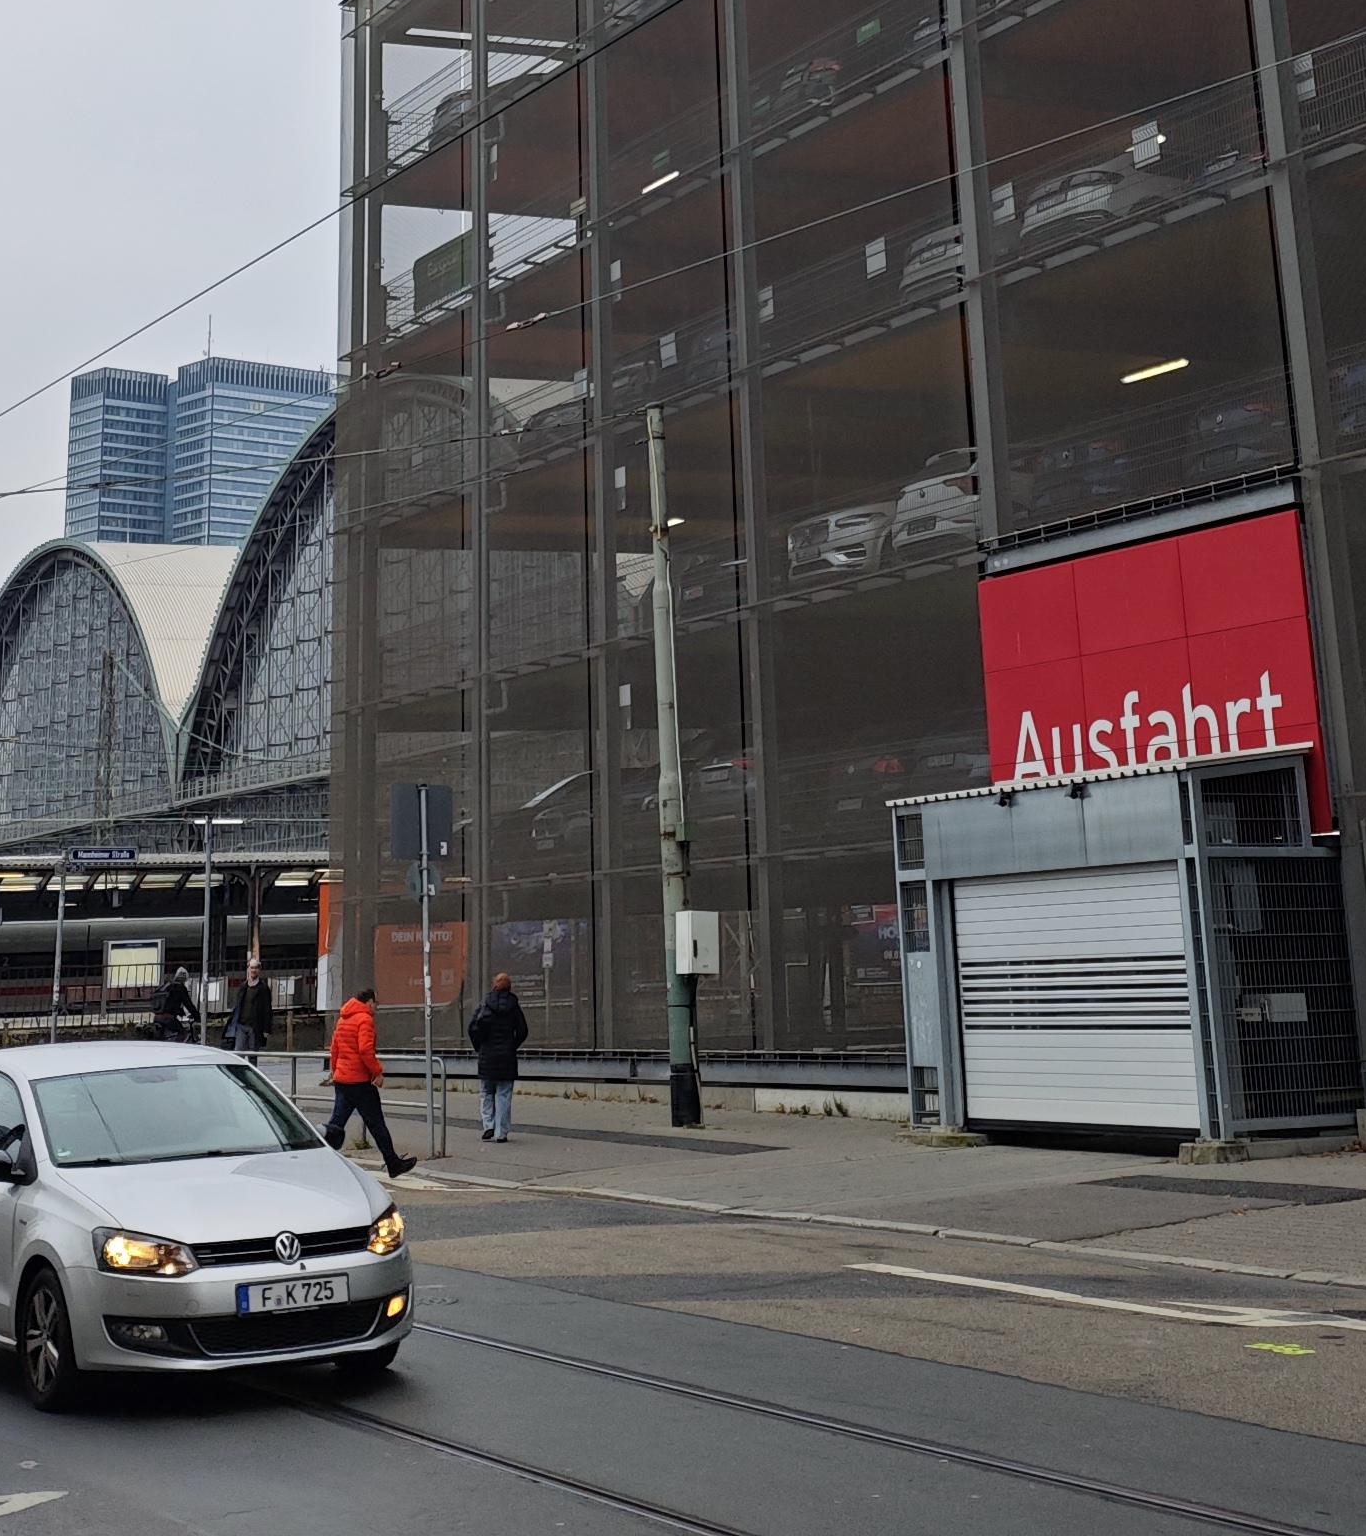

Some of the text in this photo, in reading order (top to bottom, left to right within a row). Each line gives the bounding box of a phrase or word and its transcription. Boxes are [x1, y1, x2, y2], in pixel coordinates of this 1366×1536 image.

[1014, 670, 1282, 781] Ausfahrt
[415, 930, 453, 943] KNTO!
[261, 1280, 335, 1308] F K 725
